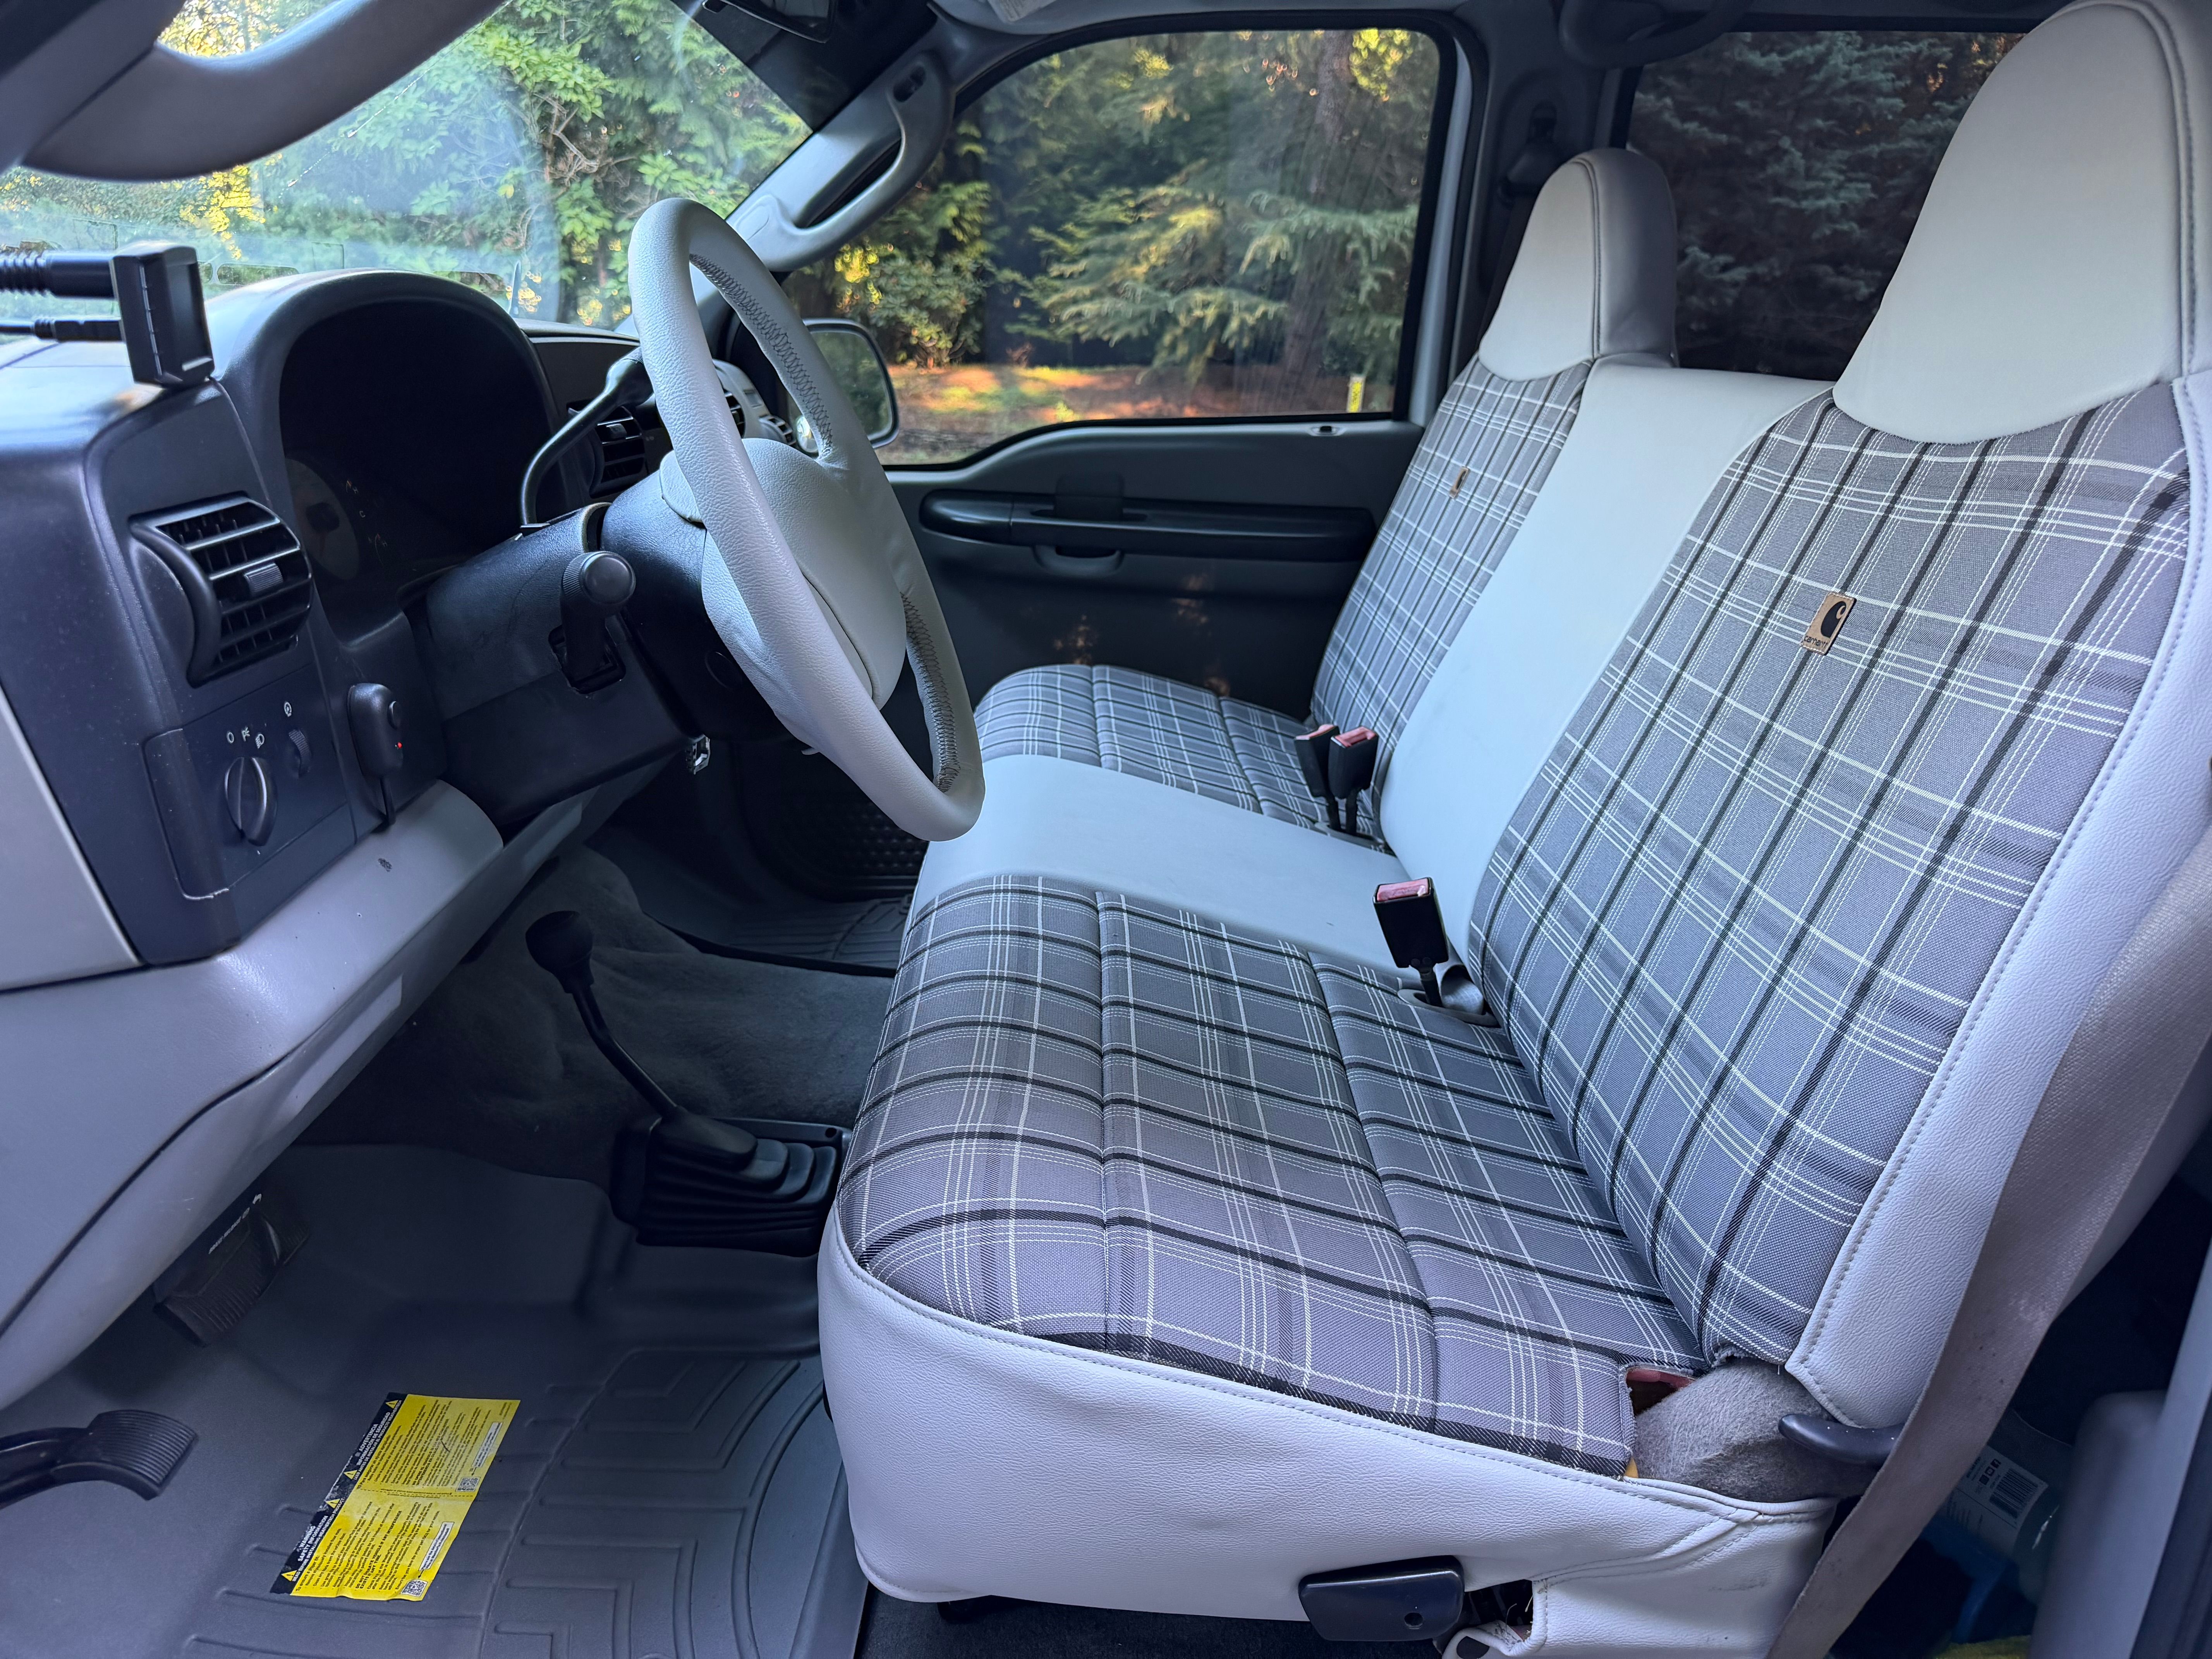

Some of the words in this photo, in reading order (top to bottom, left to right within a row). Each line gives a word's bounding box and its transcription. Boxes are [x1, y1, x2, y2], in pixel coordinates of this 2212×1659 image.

[1803, 635, 1829, 648] carhartt
[375, 1412, 390, 1433] SEGURIDAD
[359, 1424, 379, 1452] ADVERTENCIA
[297, 1544, 311, 1561] SAFETY
[307, 1515, 328, 1544] INFORMATION
[299, 1526, 316, 1547] WARNING
[306, 1537, 321, 1559] INSTALLING
